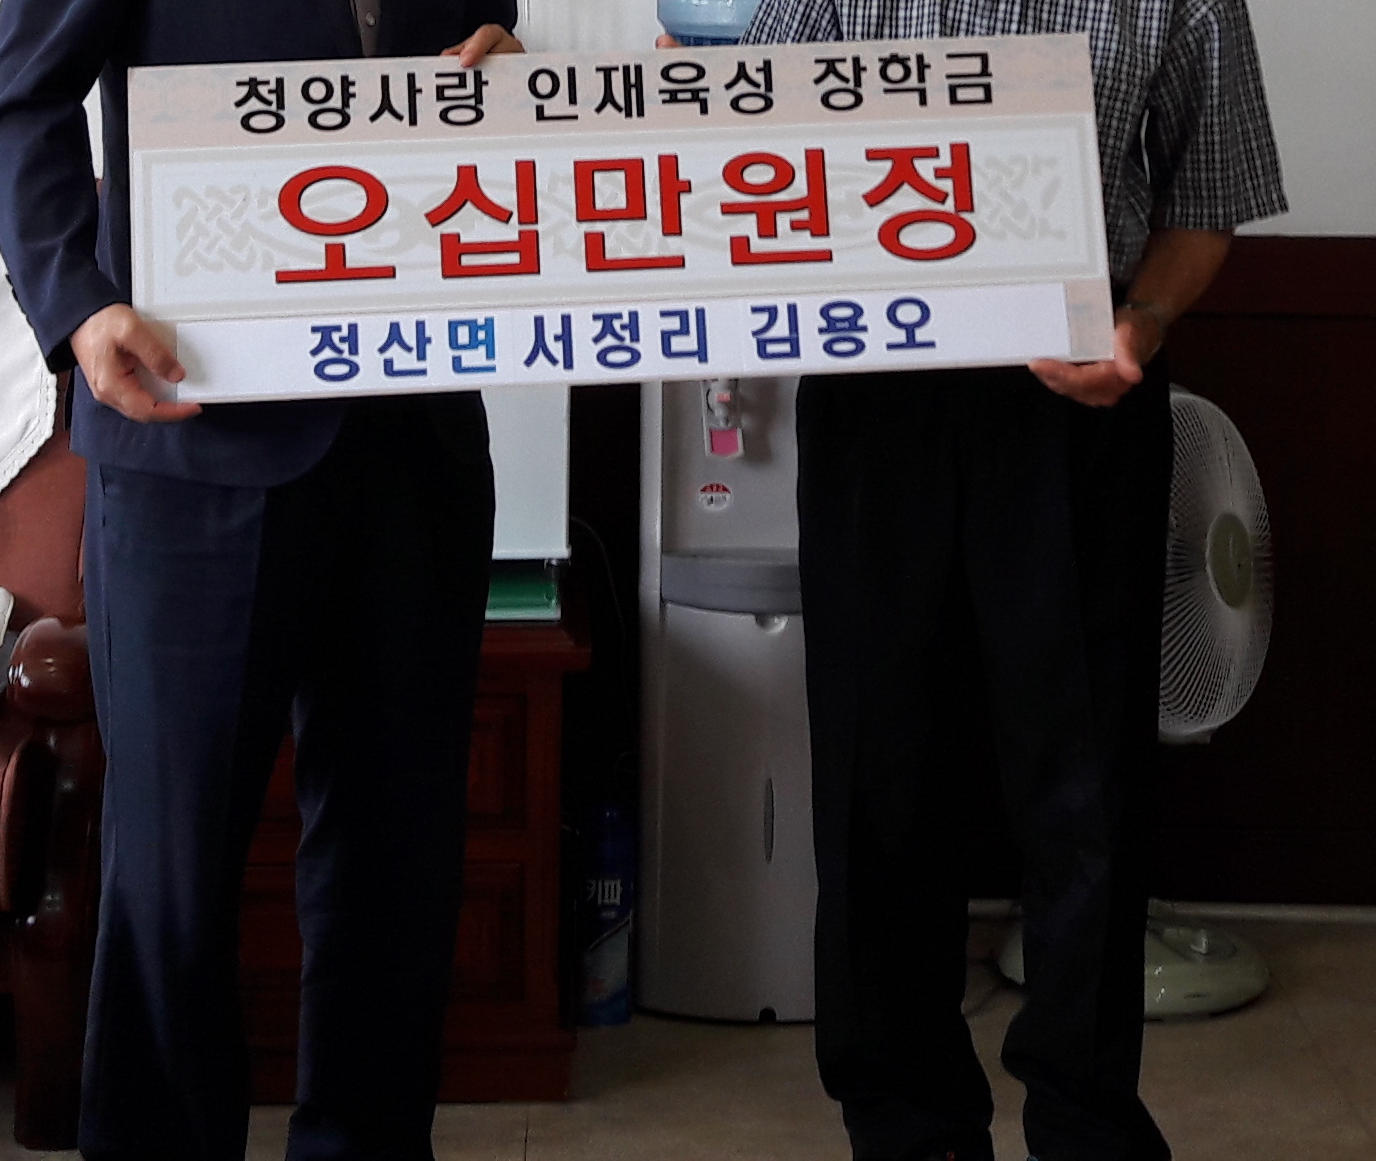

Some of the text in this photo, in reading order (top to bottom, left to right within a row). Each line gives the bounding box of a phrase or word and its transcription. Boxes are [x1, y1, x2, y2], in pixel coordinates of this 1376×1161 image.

[234, 52, 993, 134] 청양사랑 인재육성 장학금
[276, 142, 975, 283] 오십만원정
[310, 298, 935, 382] 정산면 서정리 김용오
